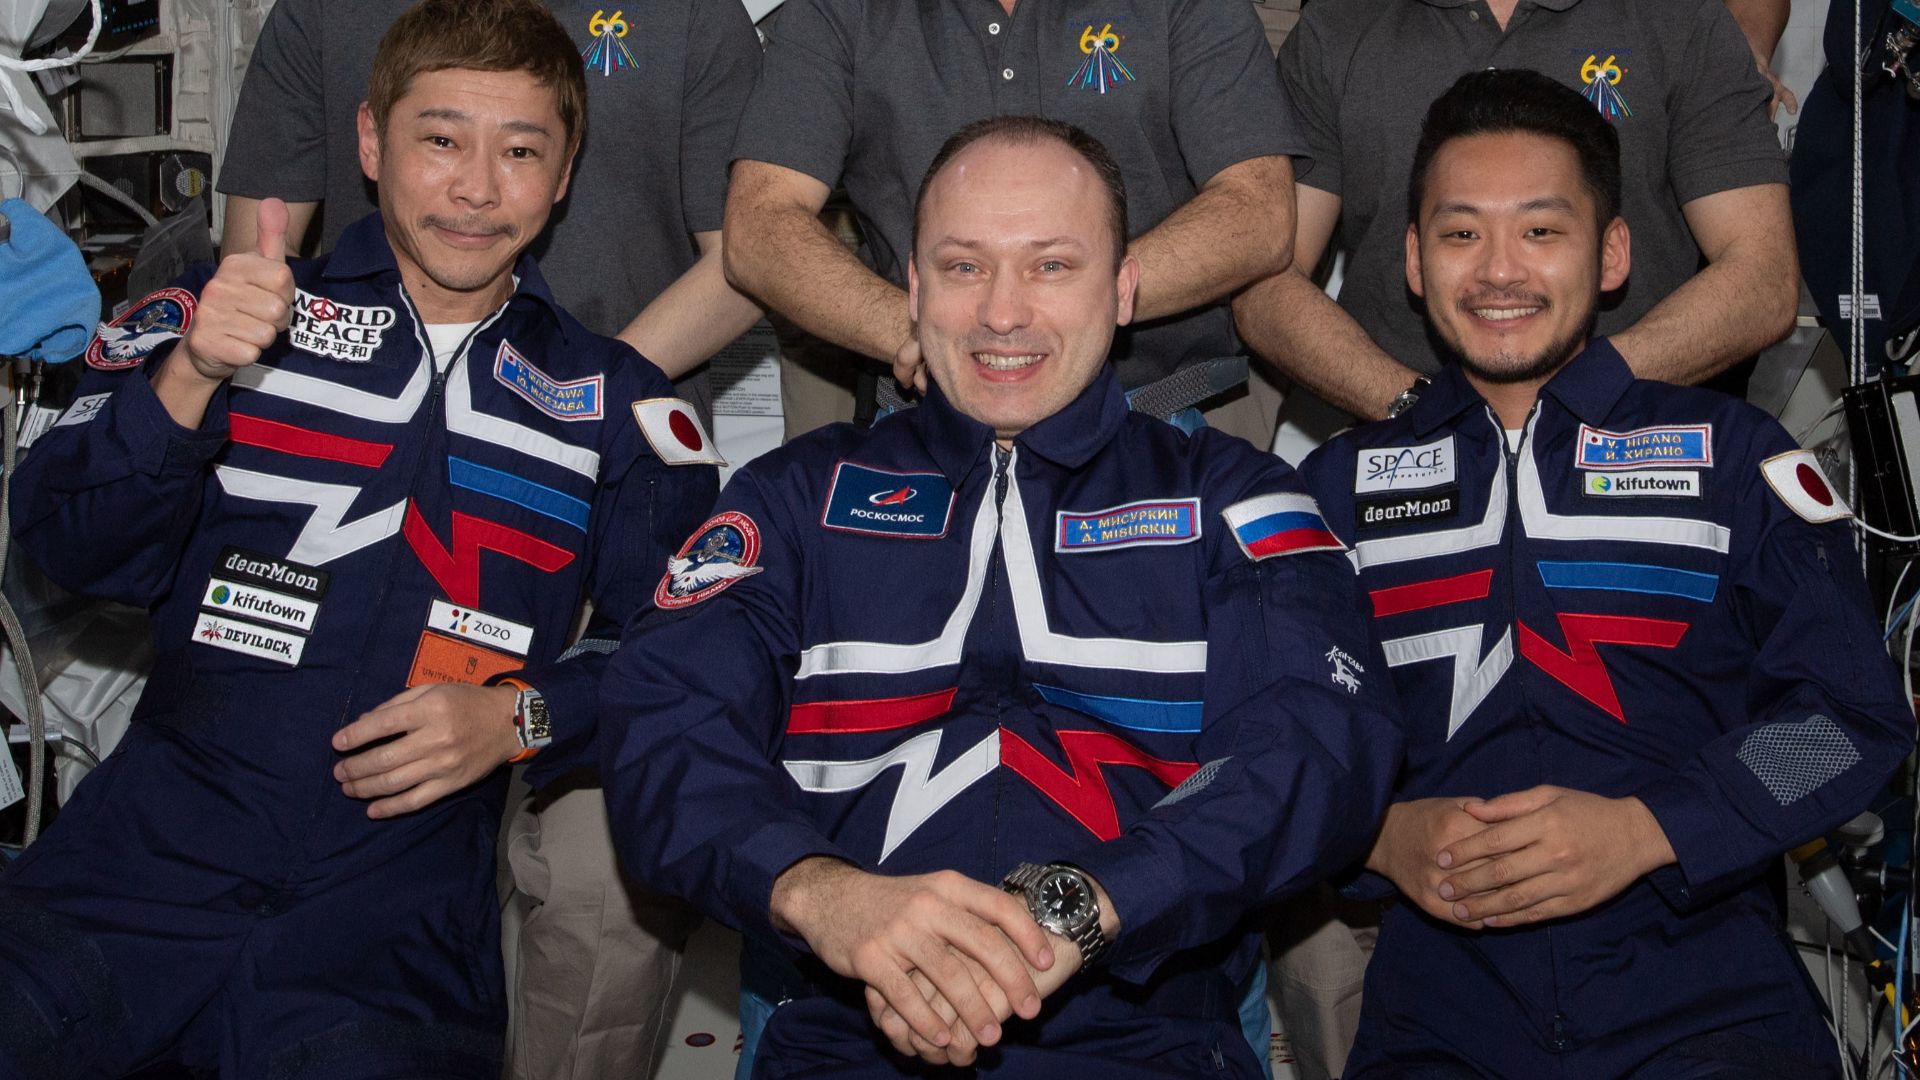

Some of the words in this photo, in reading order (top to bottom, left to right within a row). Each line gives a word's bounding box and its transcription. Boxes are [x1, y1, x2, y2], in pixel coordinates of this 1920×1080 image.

[589, 9, 629, 38] 66
[1080, 23, 1120, 54] 66
[1581, 54, 1622, 85] 66
[291, 310, 378, 344] PEACE
[294, 331, 368, 357] 世界平和
[528, 371, 584, 399] MAEZAWA
[1624, 446, 1684, 459] ХИРАНО
[1626, 434, 1682, 448] HIRANO
[1367, 447, 1444, 475] SPACE
[1616, 477, 1691, 490] kifutown
[850, 508, 925, 522] РОСКОСМОС
[1098, 509, 1178, 529] МИСУРКИН
[1365, 498, 1451, 522] dearMoon
[1101, 522, 1176, 541] MISURKIN
[225, 553, 319, 591] dearMoon
[232, 591, 306, 623] kifutown
[473, 620, 511, 640] ZOZO
